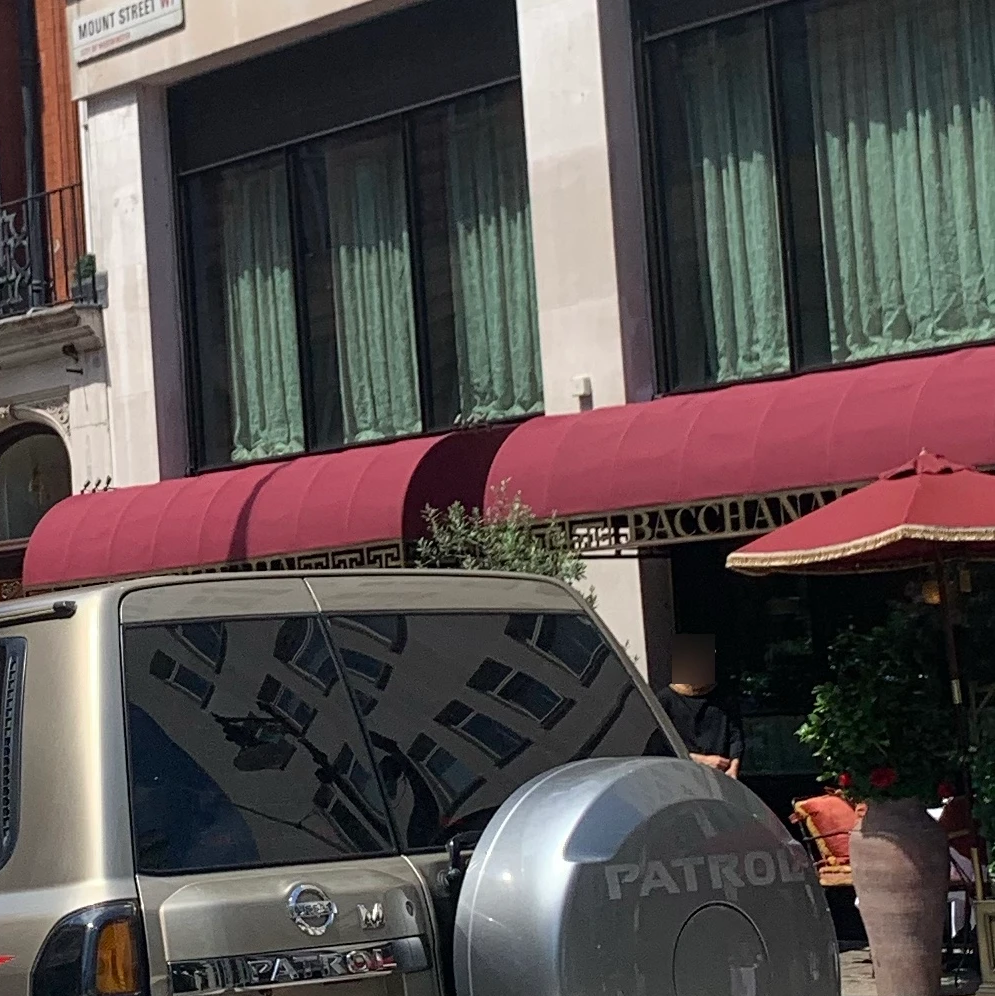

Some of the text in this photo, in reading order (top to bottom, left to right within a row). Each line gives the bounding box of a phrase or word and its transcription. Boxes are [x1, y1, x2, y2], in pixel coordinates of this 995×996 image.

[78, 12, 116, 40] MOUNT
[118, 0, 155, 25] STREET
[604, 850, 808, 901] PATROL
[247, 948, 397, 982] PATROL
